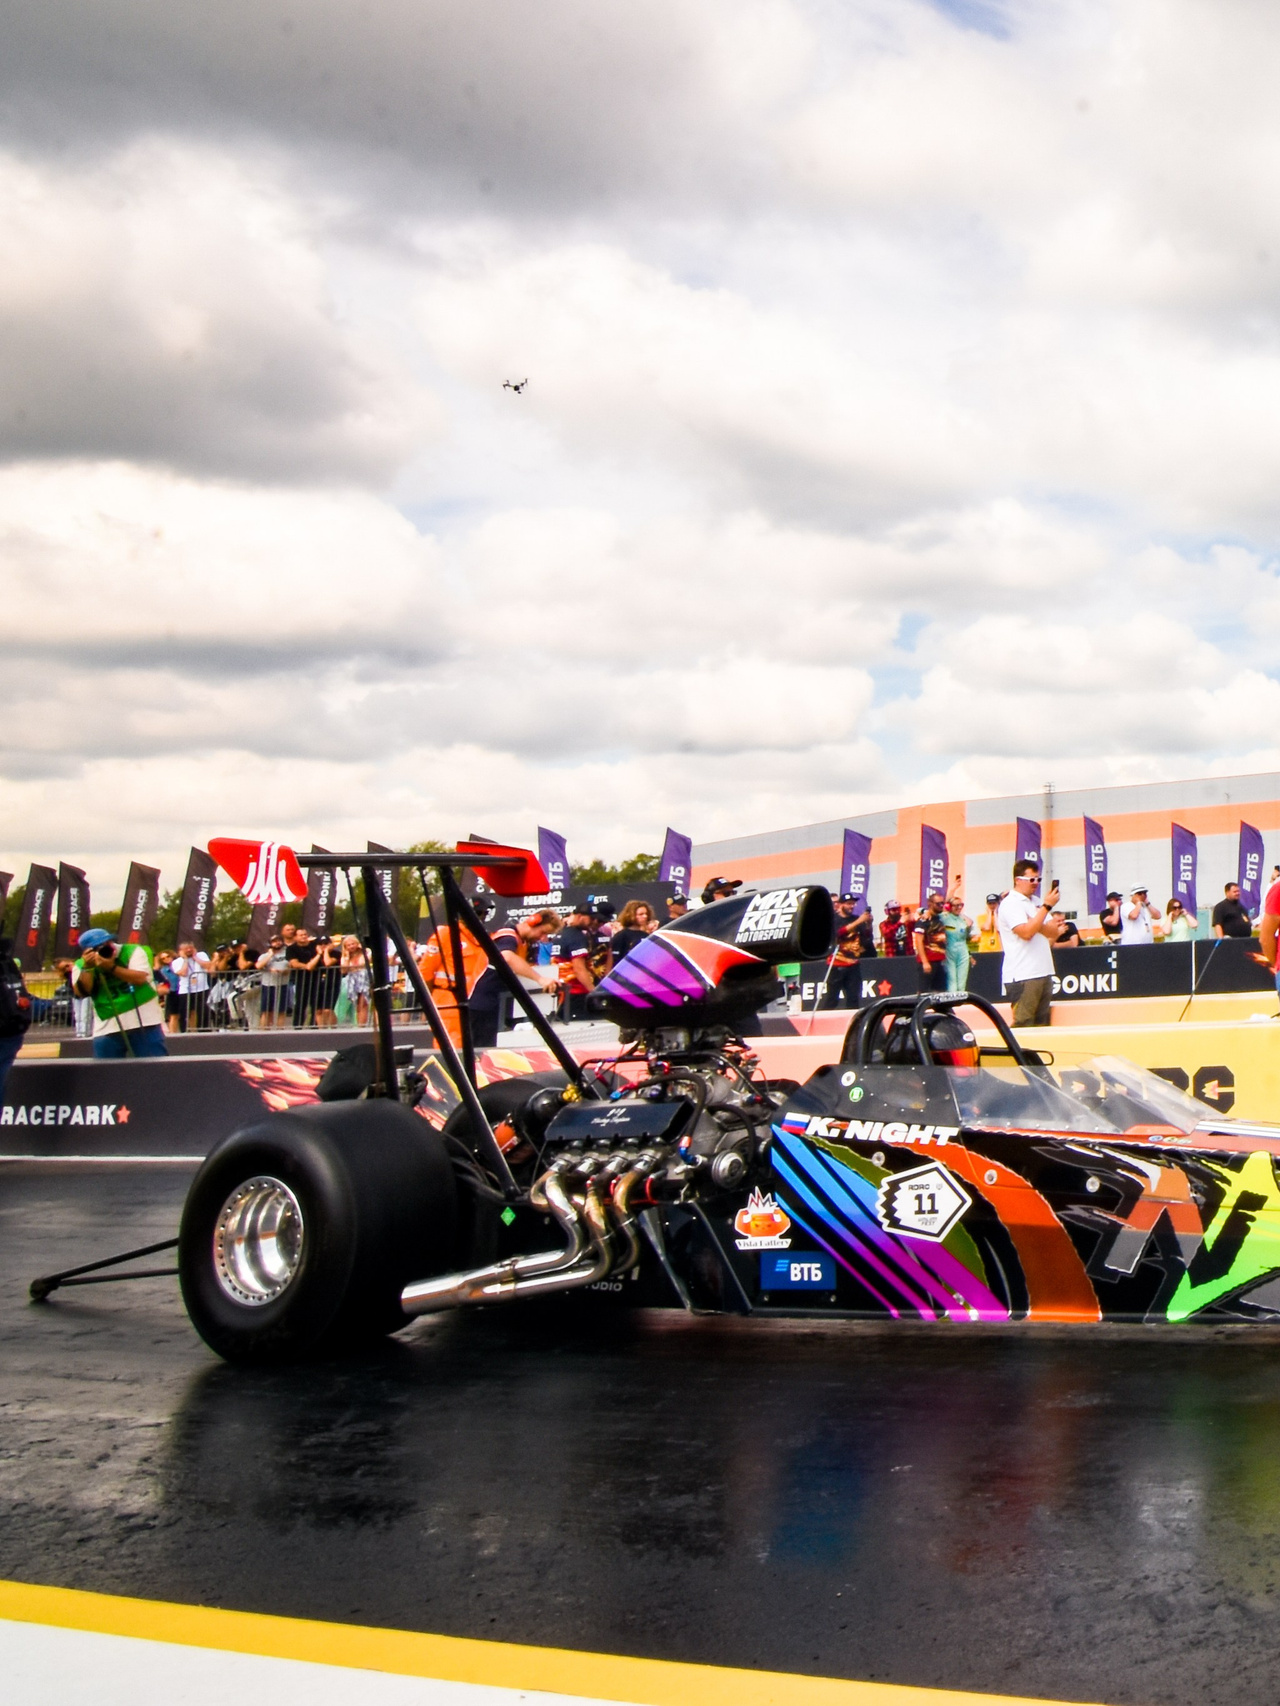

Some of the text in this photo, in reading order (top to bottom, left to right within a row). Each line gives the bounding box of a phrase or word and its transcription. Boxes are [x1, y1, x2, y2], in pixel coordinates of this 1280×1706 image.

[1091, 844, 1104, 872] ВТБ
[1180, 854, 1193, 881] ВТБ
[1246, 853, 1260, 880] ВТБ
[850, 864, 866, 894] ВТБ
[930, 859, 944, 888] ВТБ
[746, 888, 808, 911] MAX
[739, 907, 798, 932] RIDE
[735, 928, 791, 944] MOTORSPORT
[0, 1104, 117, 1126] RACEPARK
[908, 1183, 930, 1191] RDRC
[914, 1193, 939, 1215] 11
[790, 1263, 823, 1281] ВТБ
